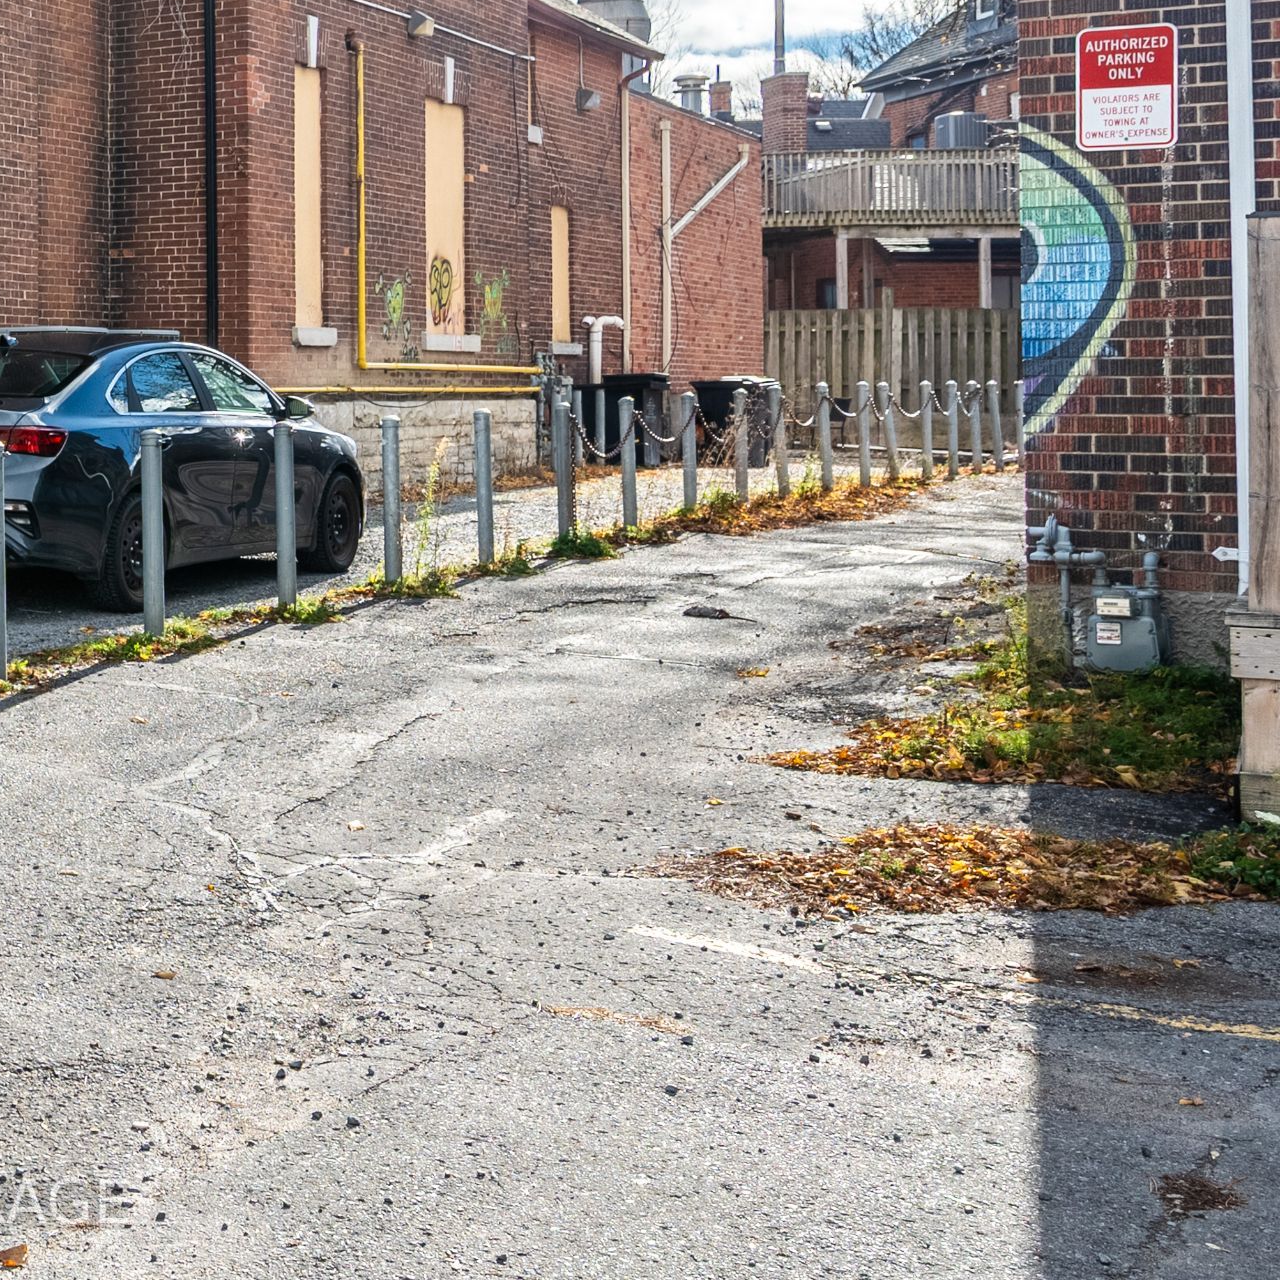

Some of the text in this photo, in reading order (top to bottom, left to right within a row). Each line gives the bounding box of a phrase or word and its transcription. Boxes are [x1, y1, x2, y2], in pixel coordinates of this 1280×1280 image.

[1085, 35, 1168, 53] AUTHORIZED
[1097, 51, 1155, 66] PARKING
[1108, 67, 1143, 80] ONLY
[1093, 92, 1160, 104] VIOLATORS ARE
[1100, 105, 1153, 115] SUBJECT TO
[1103, 117, 1149, 127] TOWING AT
[1085, 128, 1168, 139] OWNER'S EXPENSE
